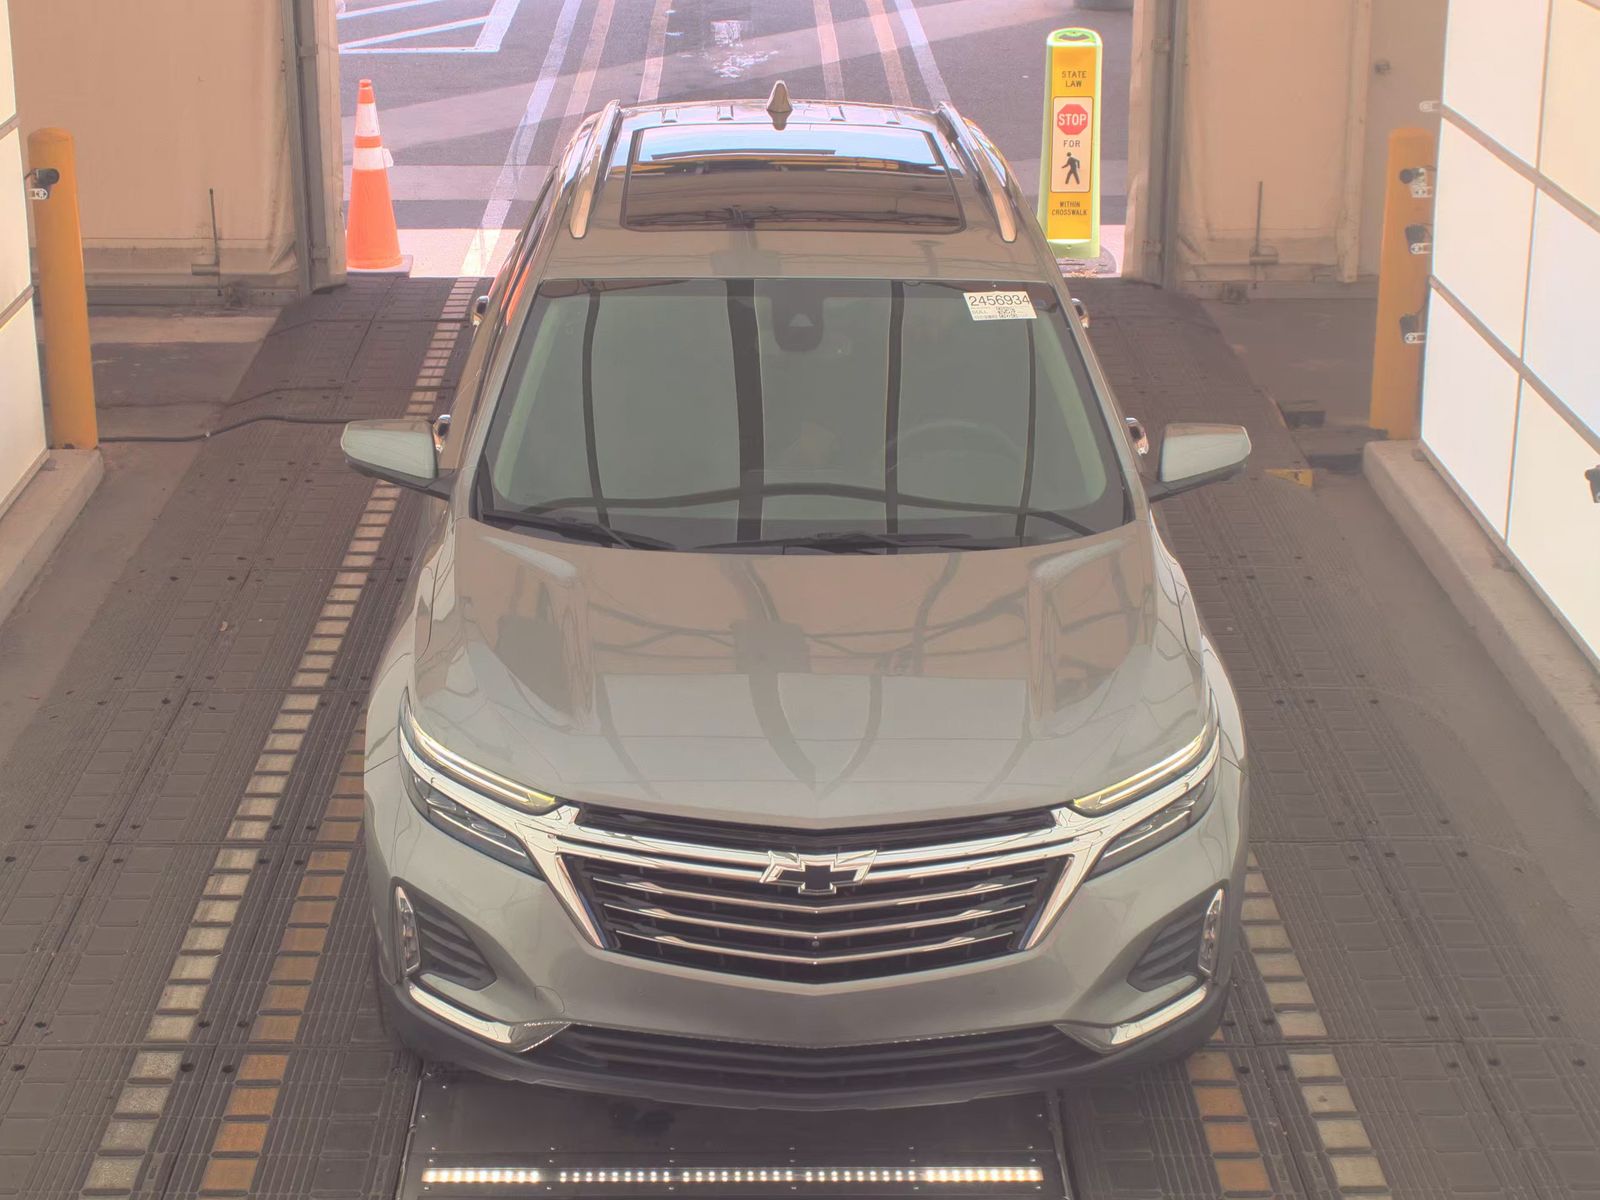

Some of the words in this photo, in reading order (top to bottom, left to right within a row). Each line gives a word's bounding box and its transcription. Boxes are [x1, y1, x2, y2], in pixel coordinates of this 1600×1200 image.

[1061, 70, 1087, 79] STATE
[1065, 80, 1082, 88] LAW
[1058, 113, 1087, 126] STOP
[1063, 140, 1081, 148] FOR
[968, 294, 1030, 307] 2456934
